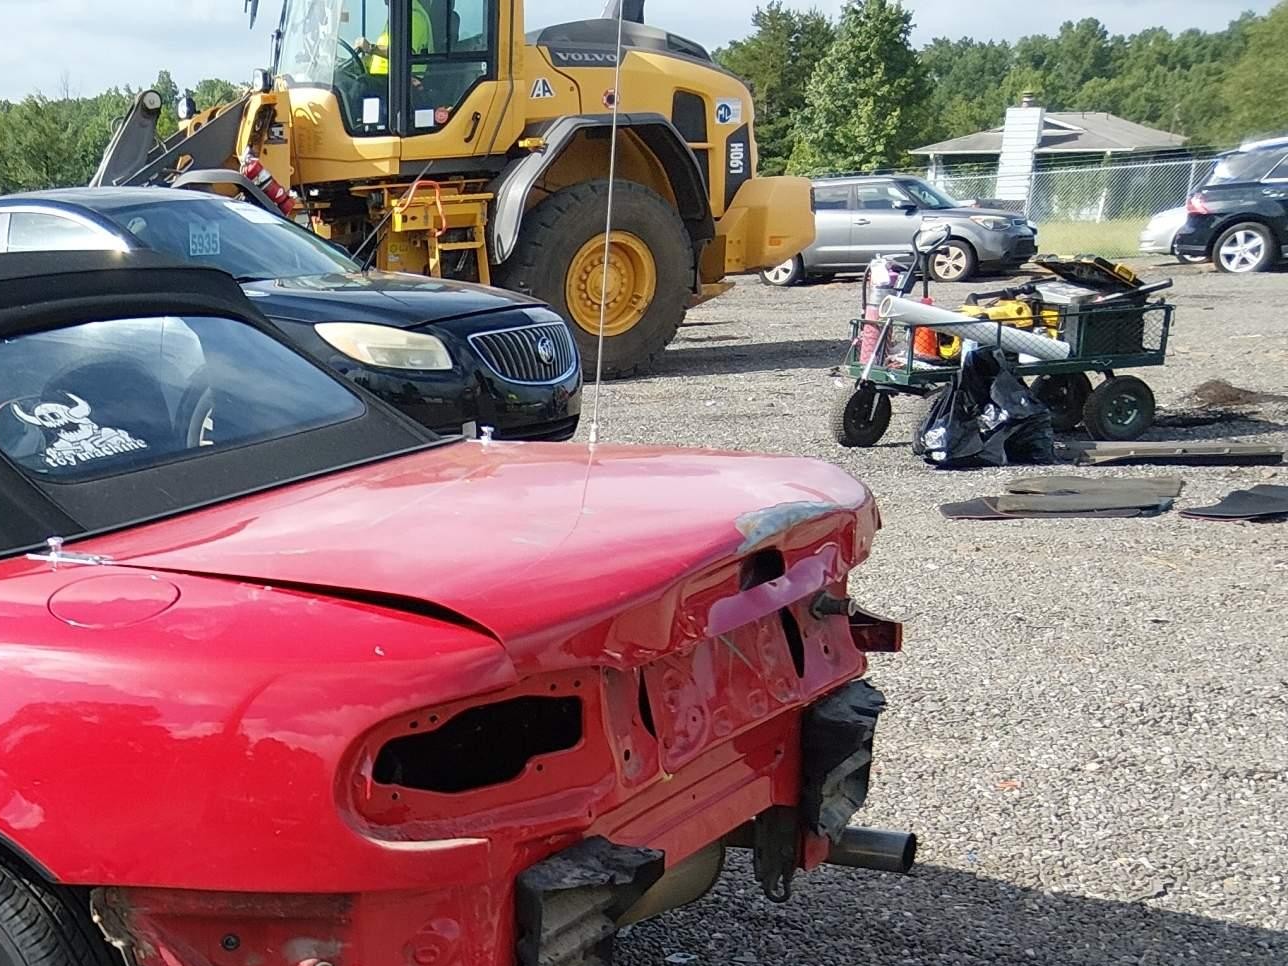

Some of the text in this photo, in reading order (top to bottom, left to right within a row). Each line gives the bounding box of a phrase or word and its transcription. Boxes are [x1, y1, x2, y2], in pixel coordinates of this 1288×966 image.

[557, 51, 618, 62] VOLVO
[729, 142, 744, 174] L90H
[191, 233, 219, 253] 5935
[45, 439, 148, 468] toy machine
